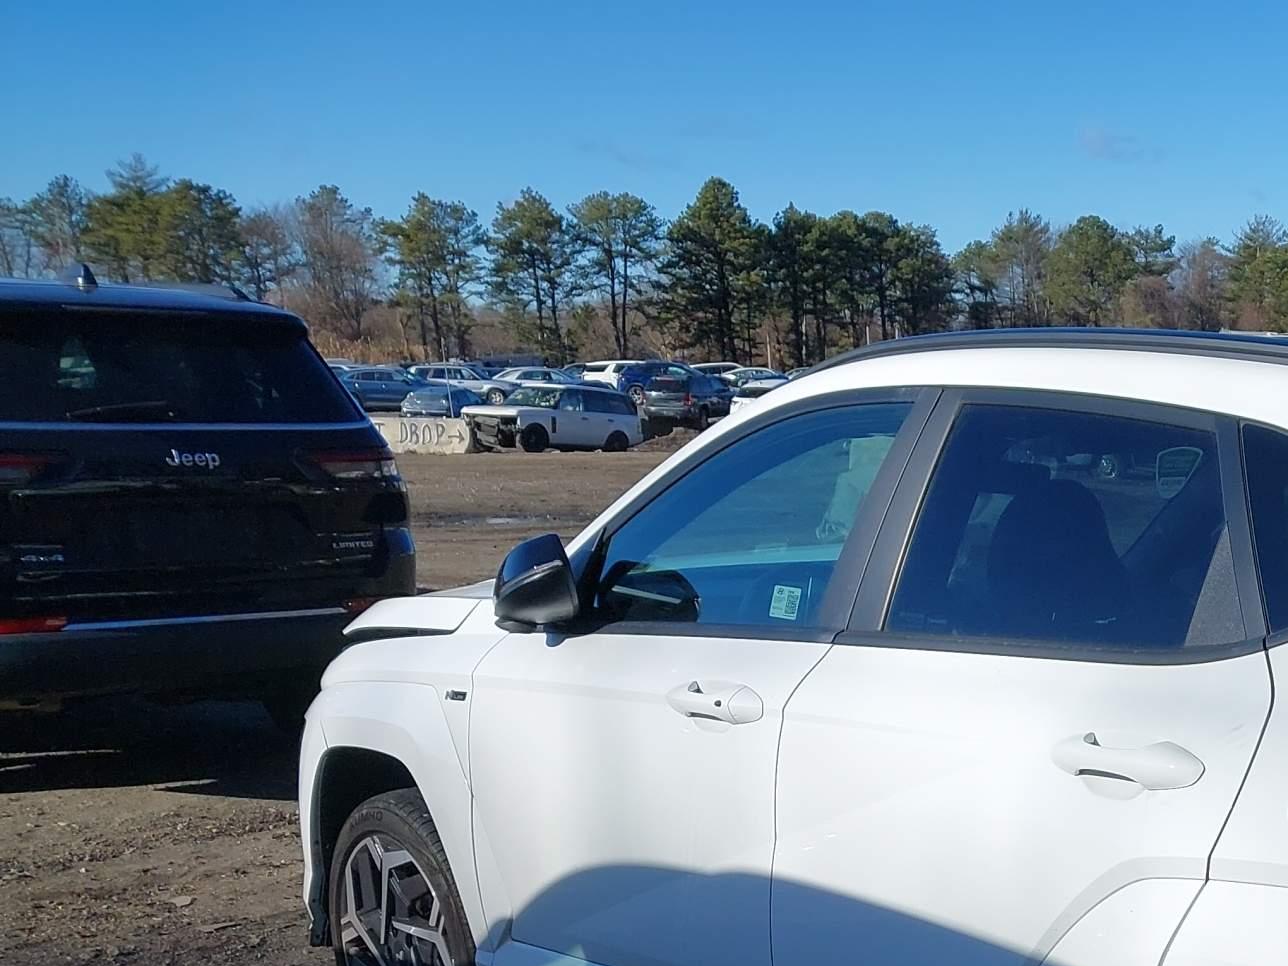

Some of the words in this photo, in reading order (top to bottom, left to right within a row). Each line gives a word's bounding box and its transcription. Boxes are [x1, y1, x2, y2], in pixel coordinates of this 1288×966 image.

[400, 421, 446, 446] DROP
[165, 449, 220, 469] Jeep
[332, 540, 374, 549] LIMITED
